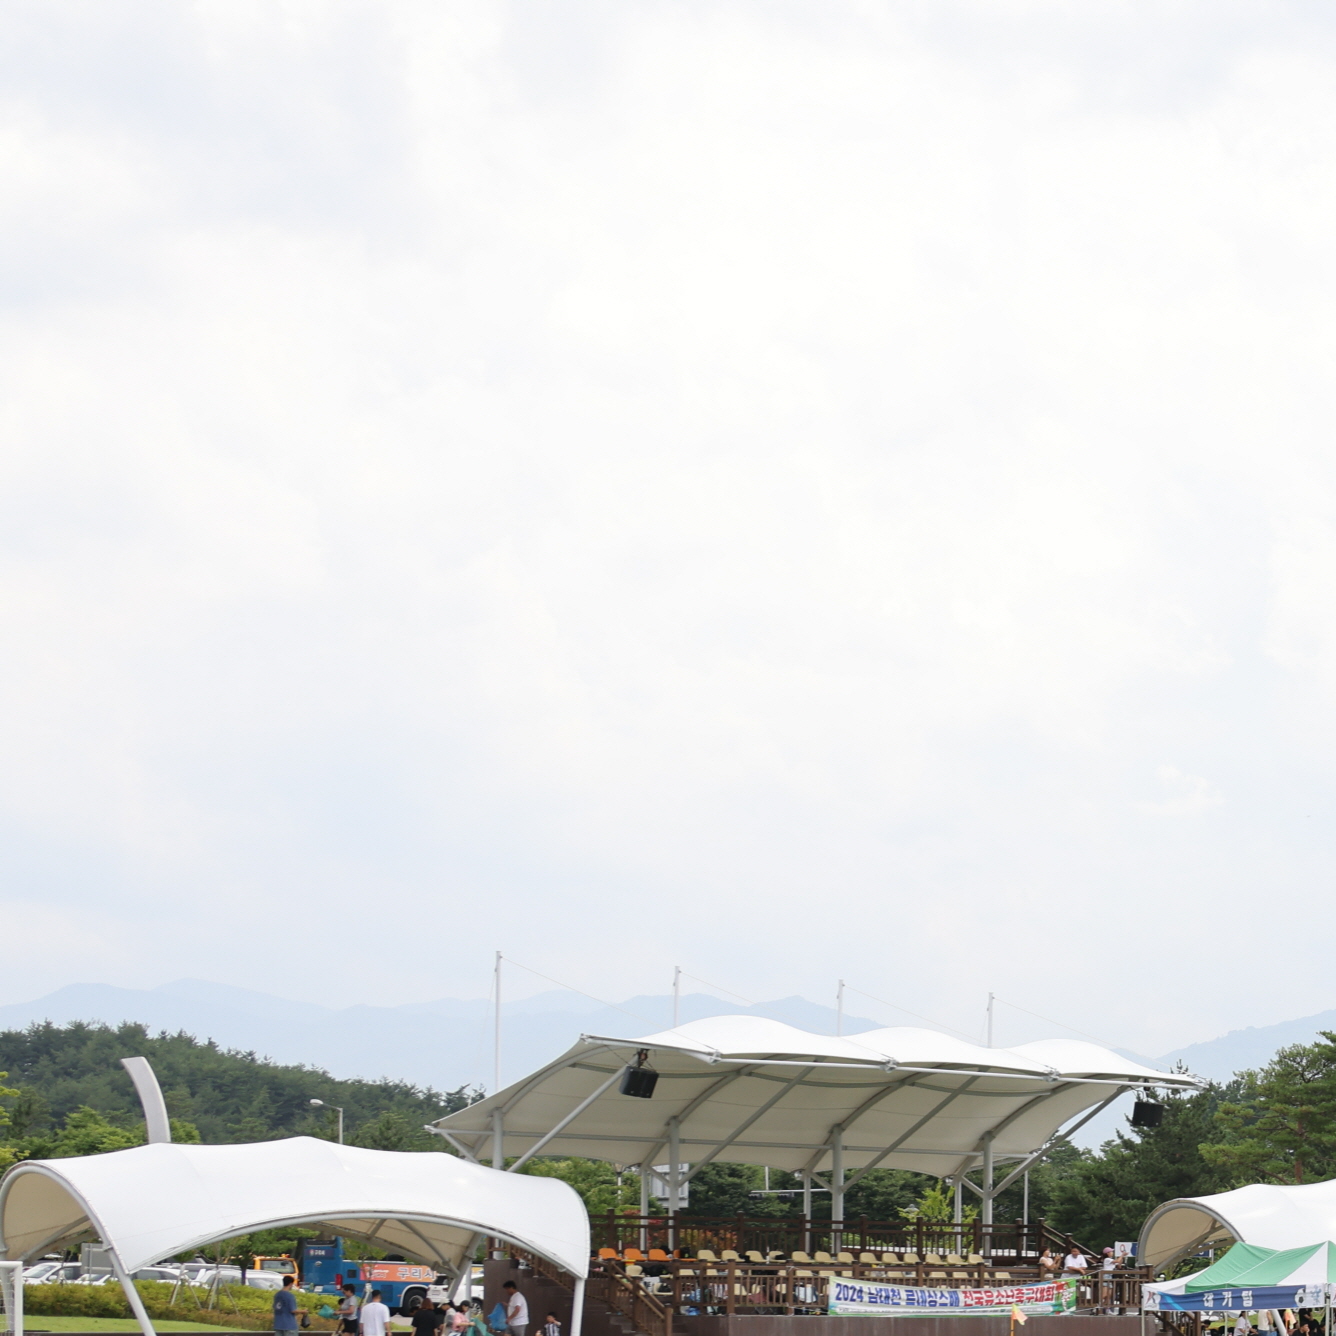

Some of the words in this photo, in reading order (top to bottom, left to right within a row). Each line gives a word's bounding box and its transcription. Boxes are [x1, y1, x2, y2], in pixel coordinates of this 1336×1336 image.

[835, 1283, 863, 1302] 2024
[868, 1287, 901, 1305] 남대천
[905, 1289, 960, 1307] 르네상스배
[962, 1285, 1055, 1307] 전국유소년축구대회
